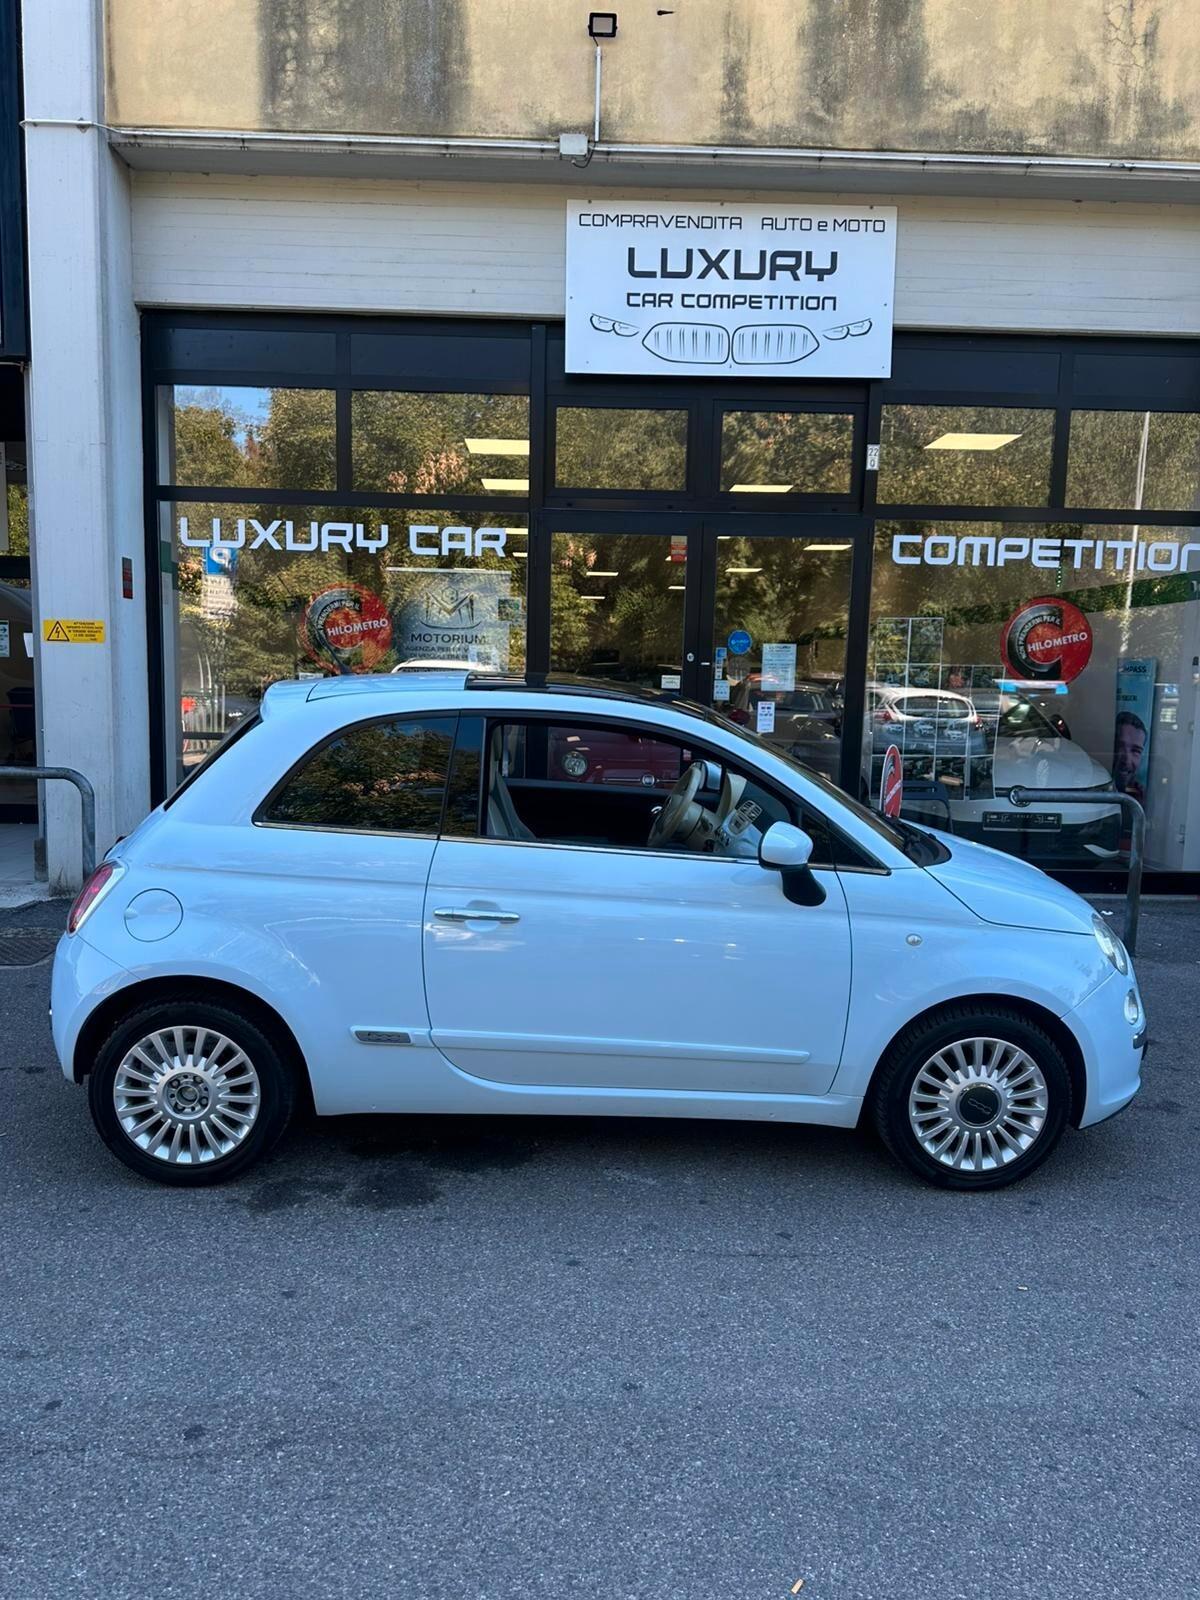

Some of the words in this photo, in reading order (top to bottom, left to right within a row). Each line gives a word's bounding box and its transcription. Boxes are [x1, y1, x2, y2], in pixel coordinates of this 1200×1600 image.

[578, 213, 743, 230] COMPRAVENDITA
[761, 217, 812, 232] AUTO
[817, 220, 828, 232] e
[832, 218, 886, 233] MOTO
[627, 247, 838, 282] LUXURY
[626, 292, 673, 308] CAR
[681, 293, 837, 311] COMPETITION
[868, 447, 879, 457] 22
[179, 517, 389, 555] LUXURY
[409, 525, 507, 558] CAR
[410, 633, 486, 644] MOTORIUM
